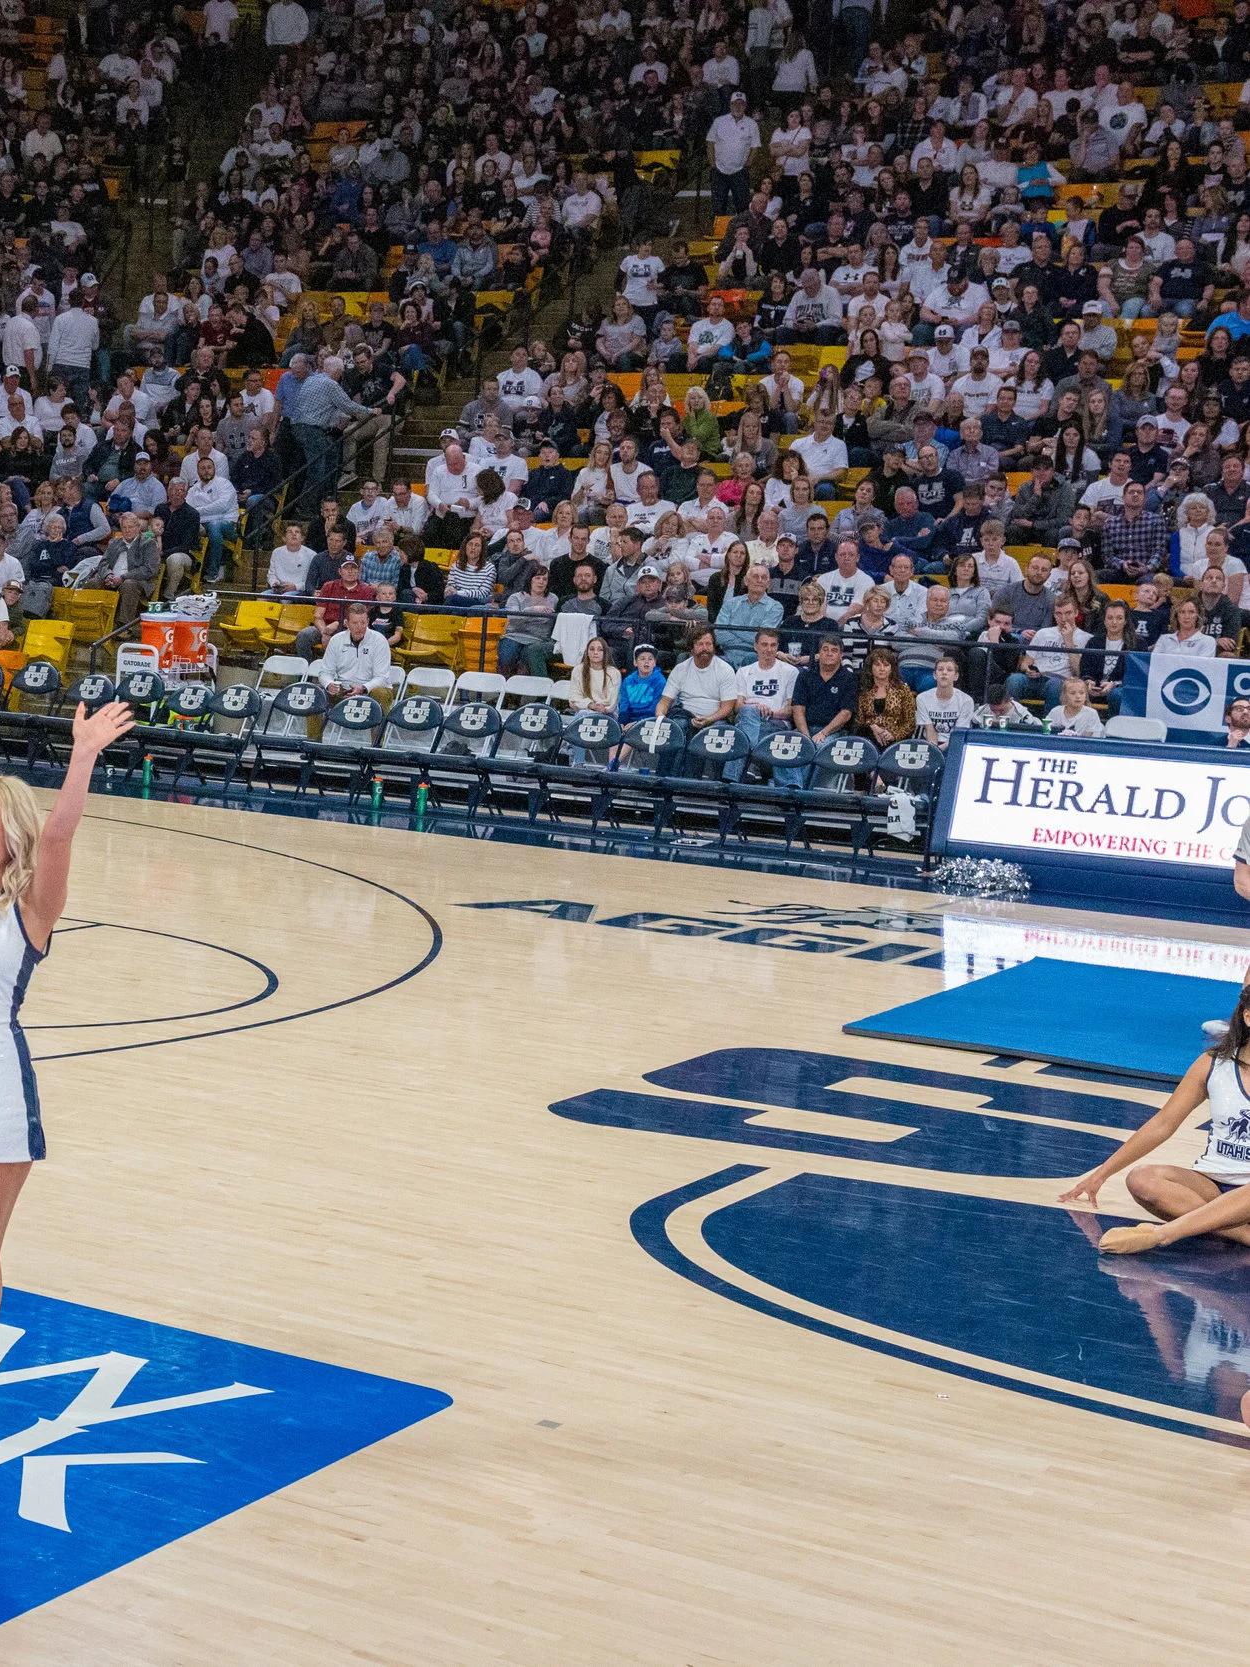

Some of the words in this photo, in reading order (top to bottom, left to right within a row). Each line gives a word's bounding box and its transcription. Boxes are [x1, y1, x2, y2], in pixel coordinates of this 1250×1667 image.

[165, 629, 174, 643] G
[199, 629, 207, 643] G
[1038, 757, 1078, 775] THE
[974, 757, 1186, 820] HERALD
[1197, 776, 1250, 834] JO
[1033, 827, 1168, 856] EMPOWERING
[1174, 840, 1214, 860] THE
[449, 898, 945, 971] AGGI
[1217, 1139, 1243, 1159] UTAH
